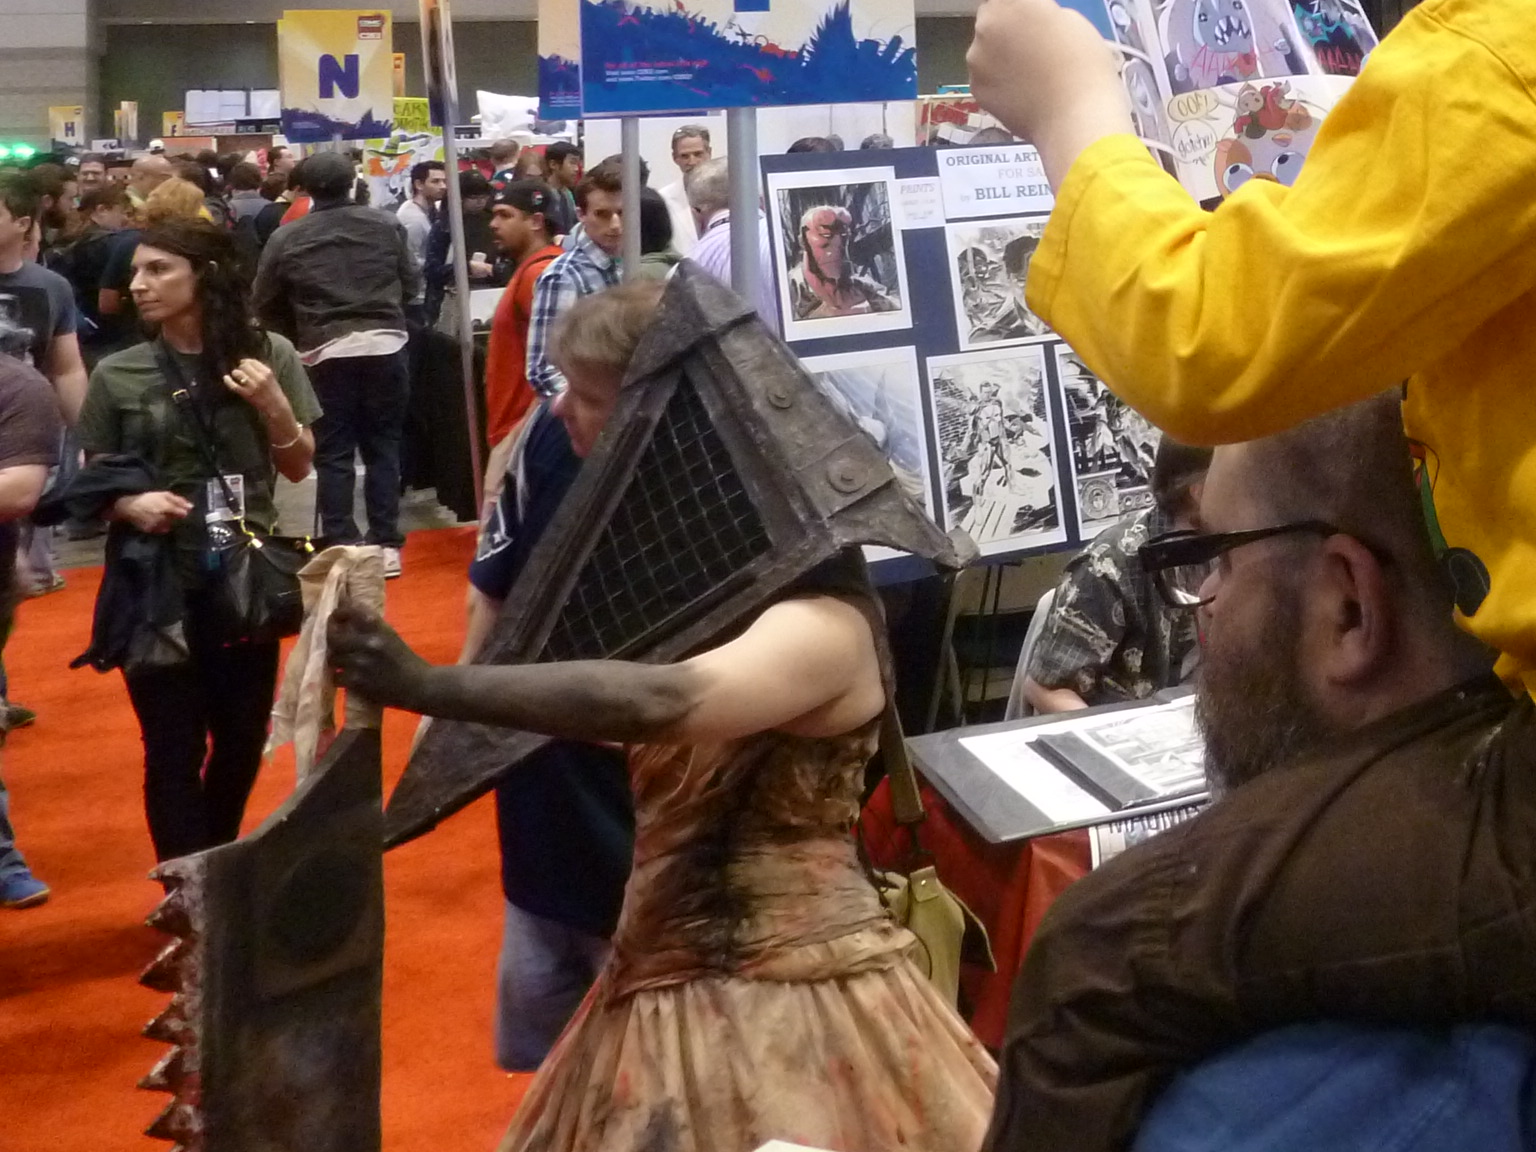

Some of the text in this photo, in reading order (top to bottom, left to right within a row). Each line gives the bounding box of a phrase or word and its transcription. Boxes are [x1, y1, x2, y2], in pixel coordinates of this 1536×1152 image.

[318, 53, 360, 99] N
[64, 121, 75, 137] H
[946, 153, 1010, 167] ORIGINAL
[998, 166, 1045, 180] FOR SA
[975, 186, 1011, 200] BILL
[1016, 183, 1054, 198] REIN
